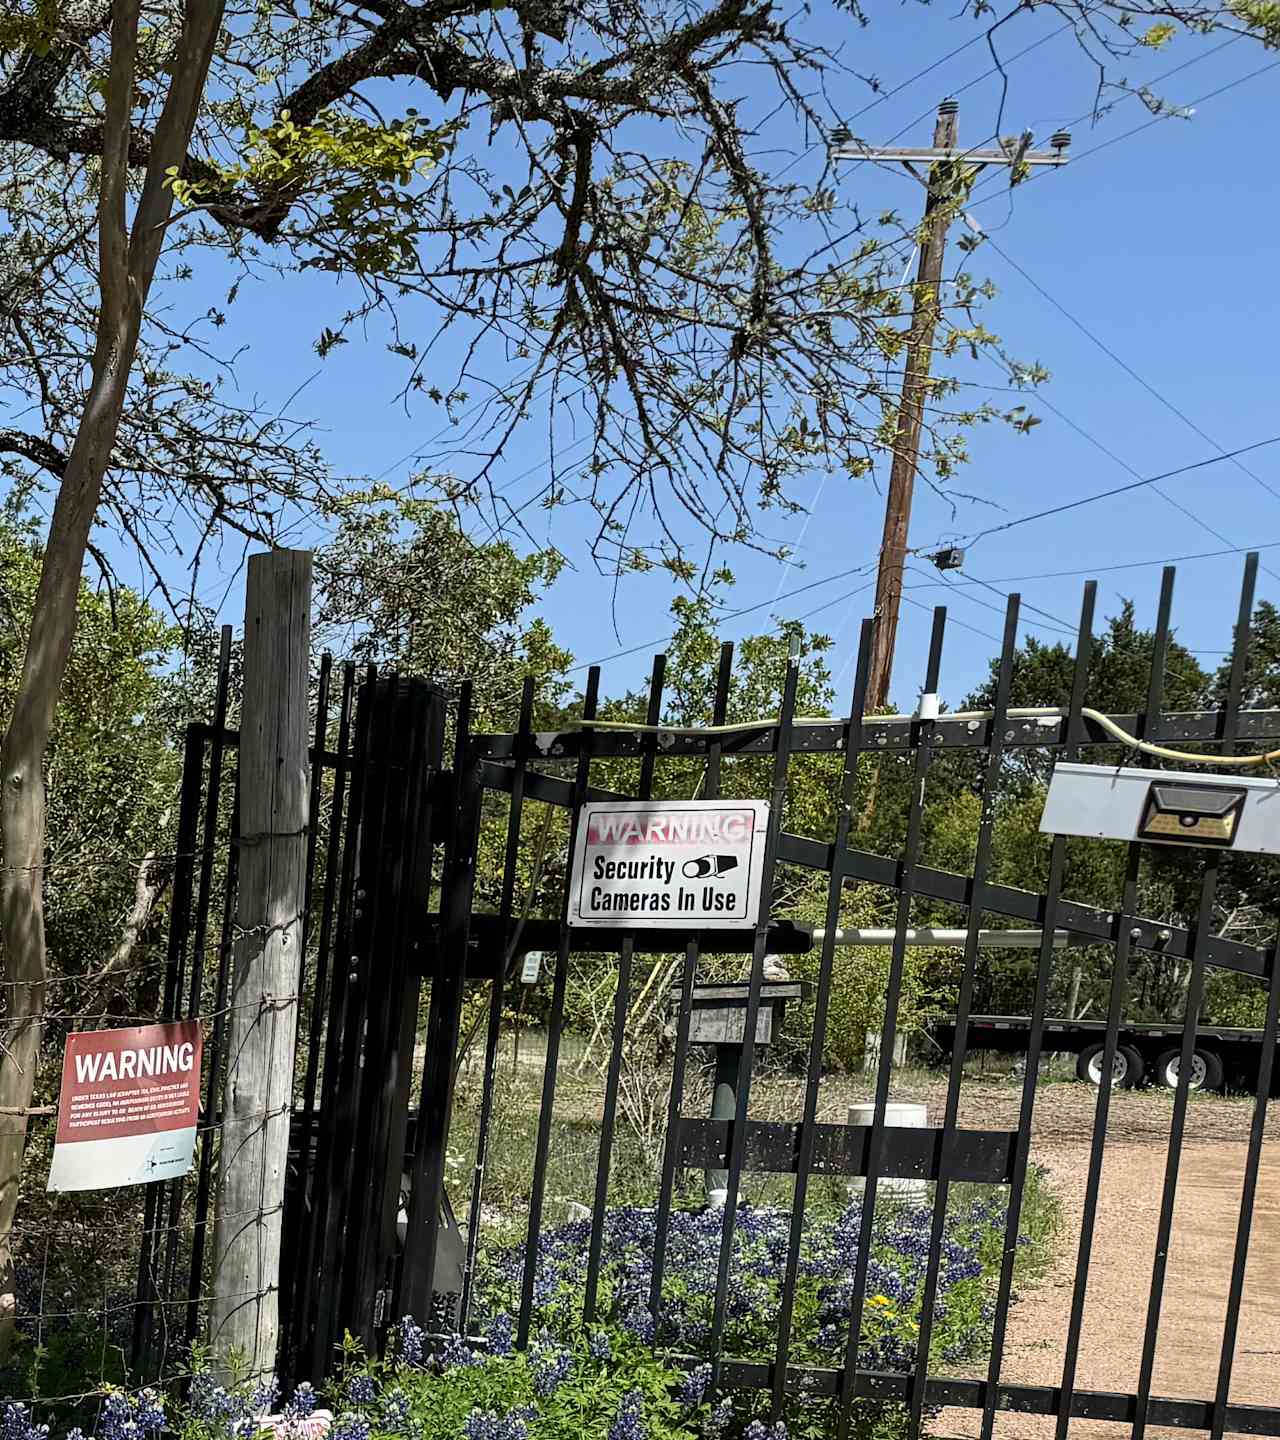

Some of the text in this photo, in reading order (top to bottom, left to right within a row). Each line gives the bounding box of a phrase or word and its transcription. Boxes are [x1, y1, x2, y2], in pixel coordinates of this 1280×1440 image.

[595, 813, 747, 843] WARNING
[593, 855, 676, 885] Security
[590, 886, 736, 912] Cameras In Use
[74, 1041, 194, 1084] WARNING
